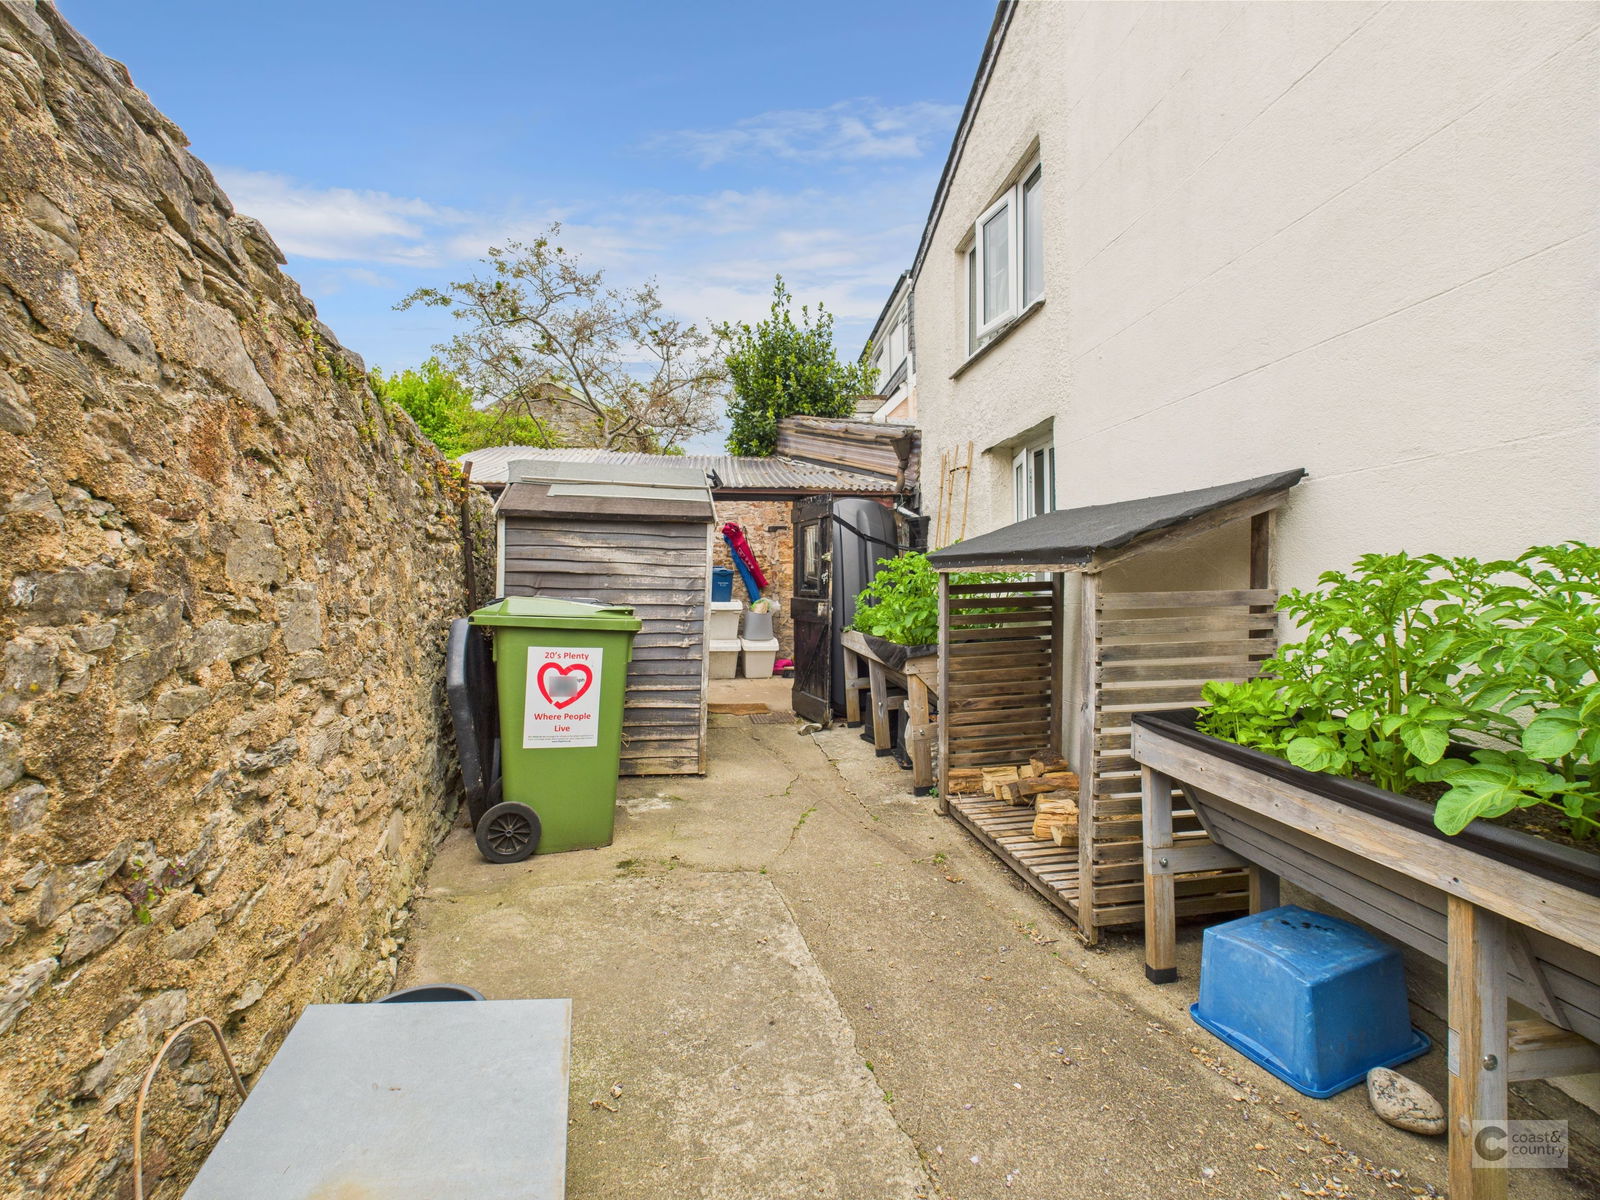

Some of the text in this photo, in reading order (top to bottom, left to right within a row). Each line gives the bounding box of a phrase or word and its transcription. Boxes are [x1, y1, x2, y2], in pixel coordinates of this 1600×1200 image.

[563, 652, 589, 660] Plenty
[534, 713, 591, 721] Where People
